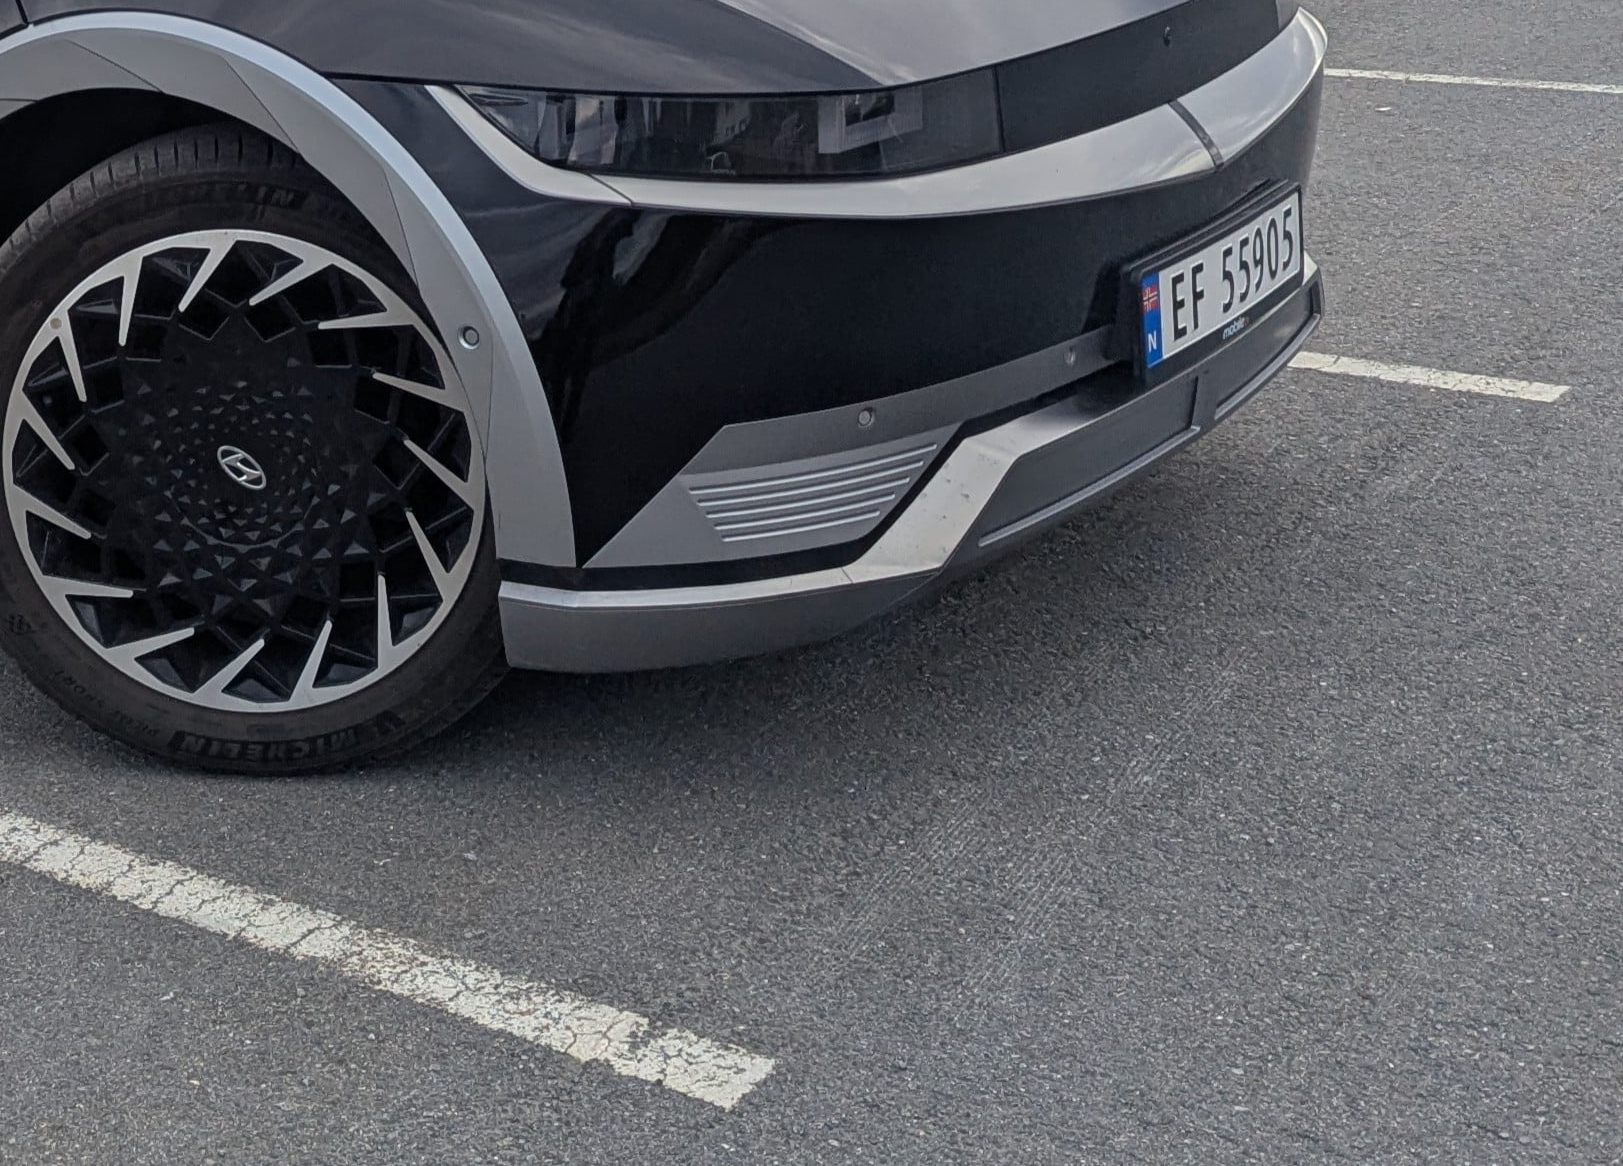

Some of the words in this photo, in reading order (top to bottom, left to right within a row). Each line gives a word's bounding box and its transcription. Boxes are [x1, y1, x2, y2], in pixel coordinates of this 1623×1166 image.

[1172, 261, 1204, 341] EF
[1222, 206, 1293, 314] 55905
[1147, 331, 1157, 353] N
[177, 727, 359, 762] MICHELIN
